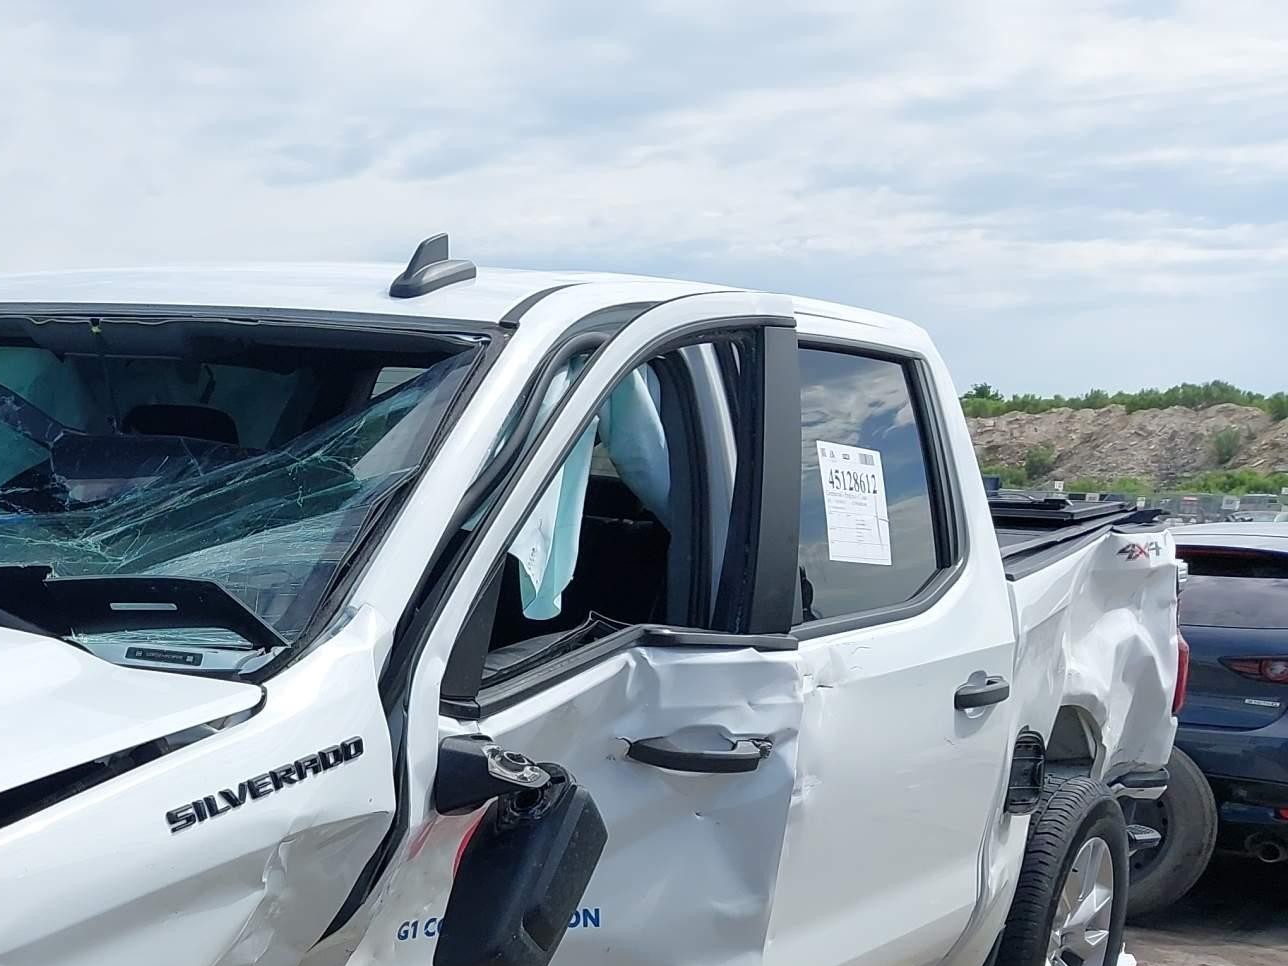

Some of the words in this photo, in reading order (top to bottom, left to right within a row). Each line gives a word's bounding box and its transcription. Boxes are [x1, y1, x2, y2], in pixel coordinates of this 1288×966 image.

[828, 469, 878, 494] 45128612
[166, 736, 364, 833] SILVERADO
[397, 920, 419, 941] G1
